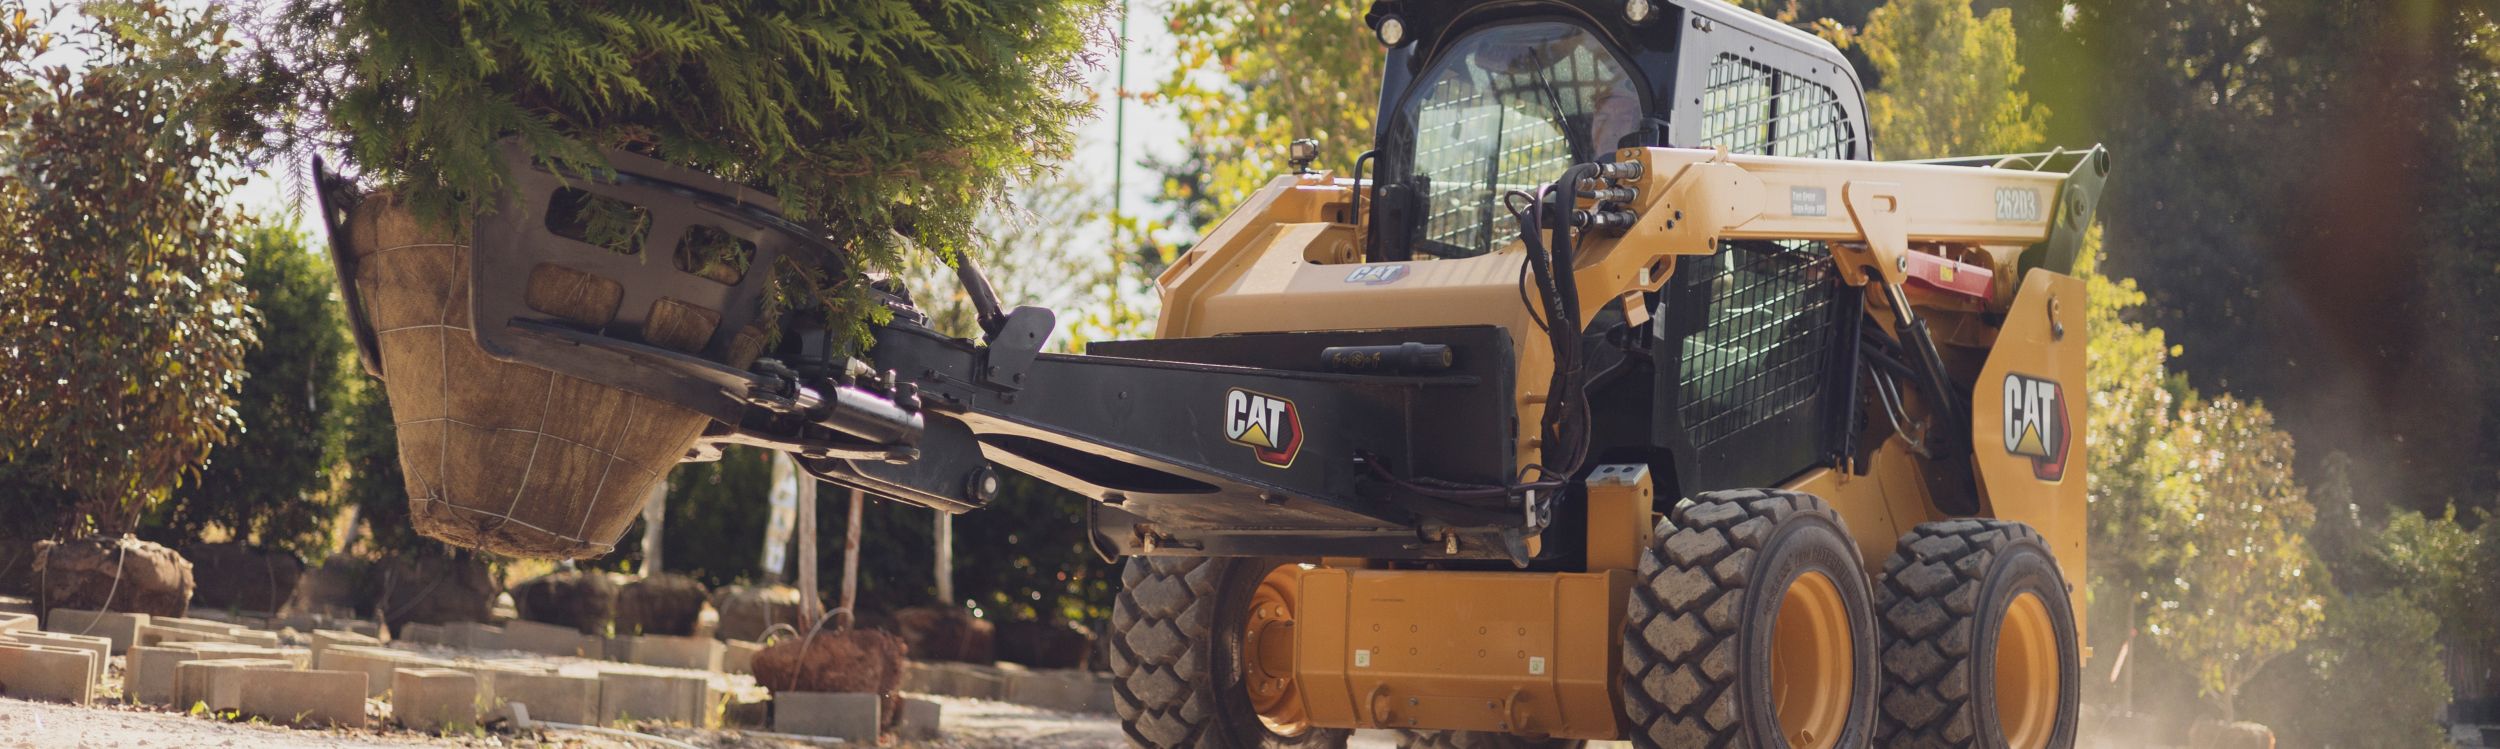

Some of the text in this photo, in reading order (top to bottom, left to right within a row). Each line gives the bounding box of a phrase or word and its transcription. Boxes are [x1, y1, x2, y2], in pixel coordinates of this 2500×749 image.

[1346, 265, 1403, 282] CAT
[1226, 390, 1286, 449] CAT
[2005, 374, 2055, 457] CAT
